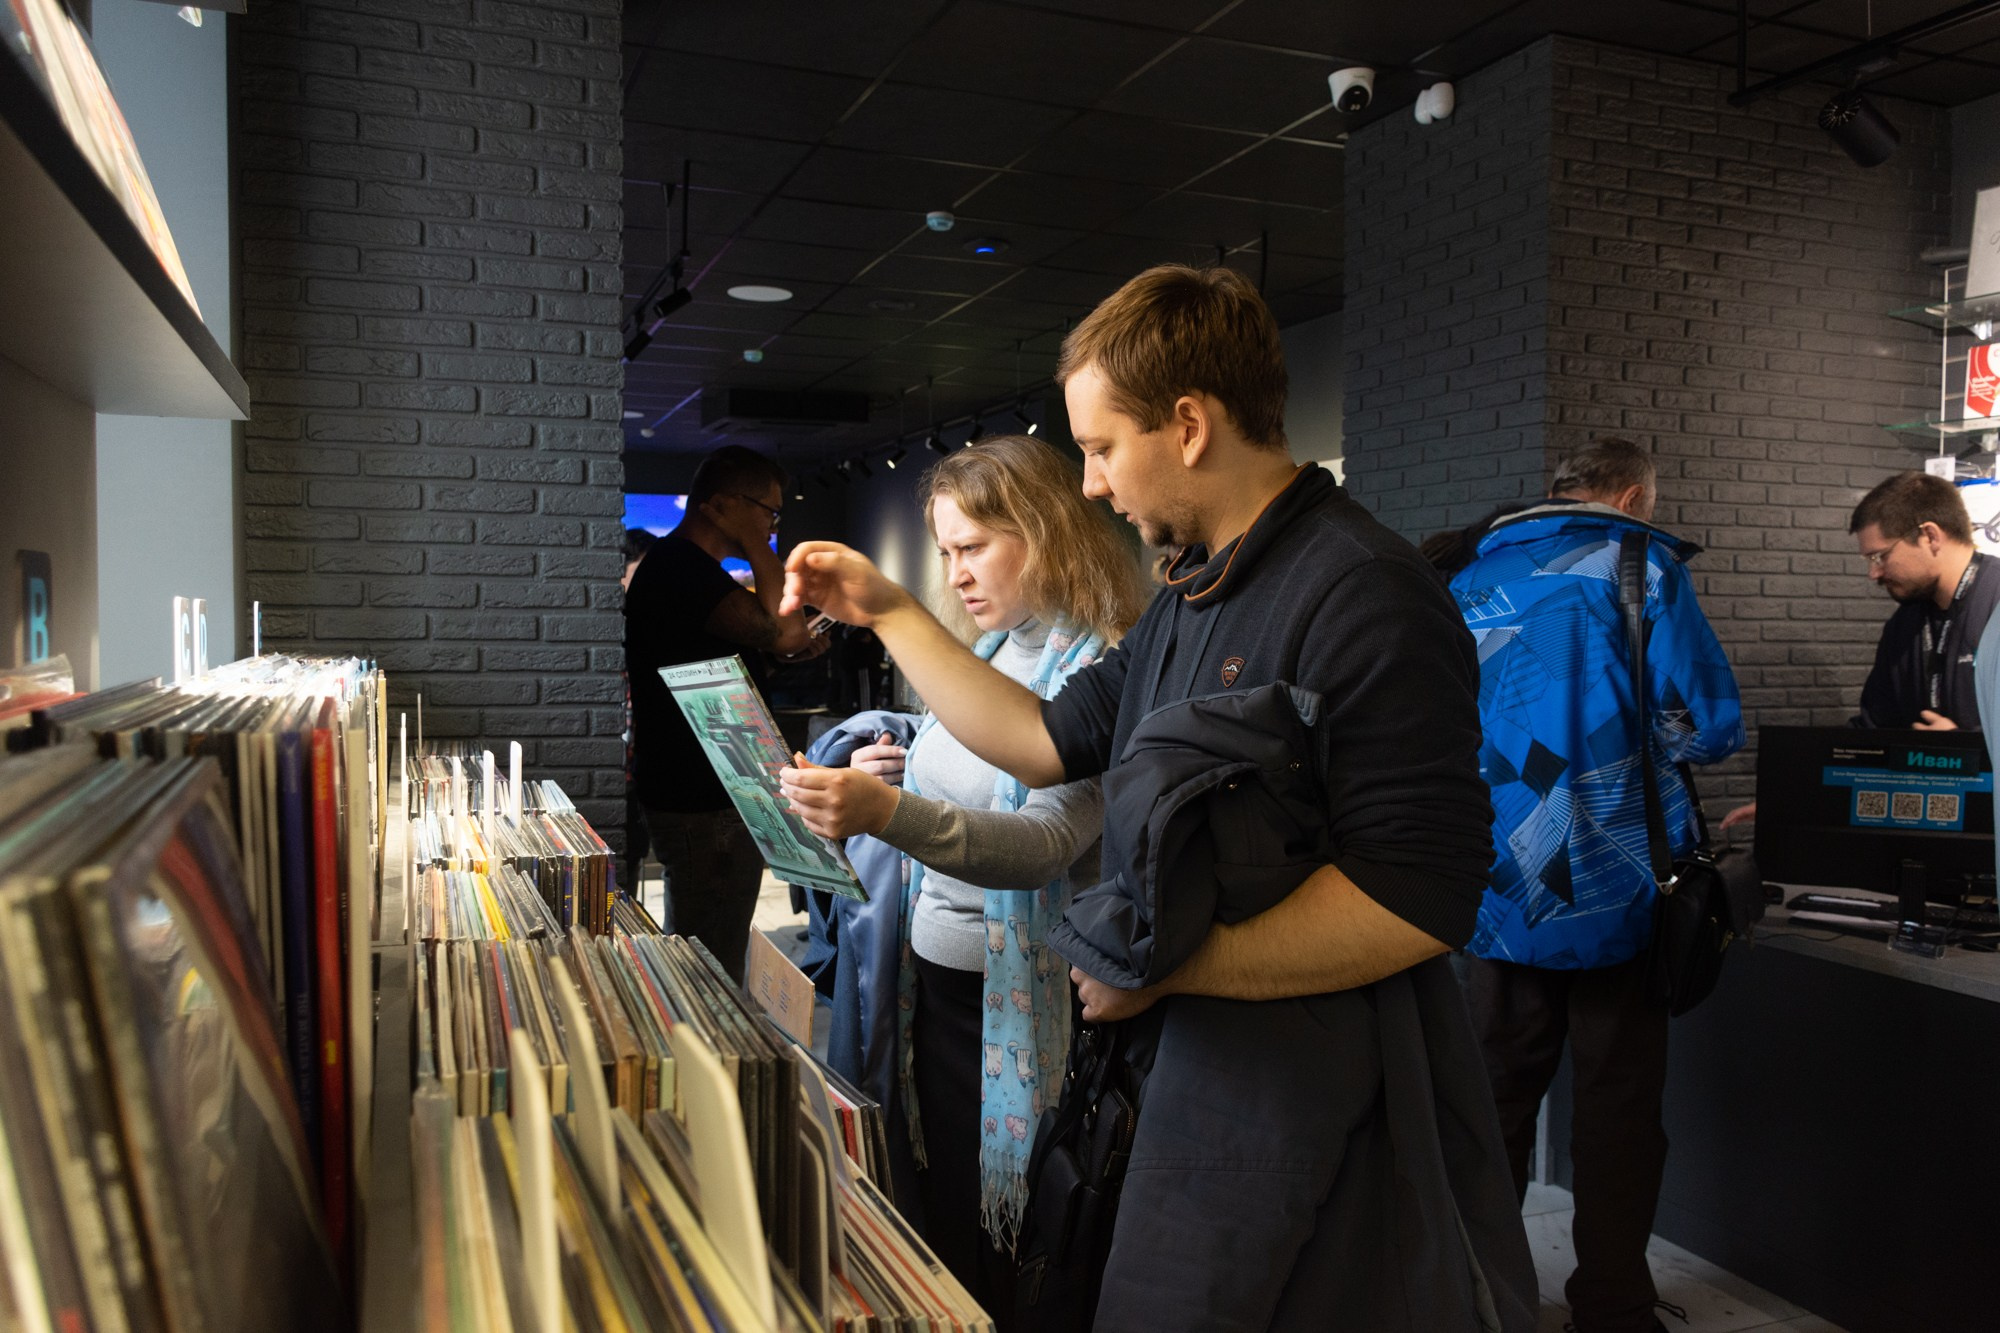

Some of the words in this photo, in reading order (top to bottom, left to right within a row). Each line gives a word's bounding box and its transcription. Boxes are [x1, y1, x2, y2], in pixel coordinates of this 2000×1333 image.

[29, 577, 49, 665] B
[181, 612, 190, 670] C
[200, 613, 207, 666] D
[1906, 751, 1963, 769] Иван
